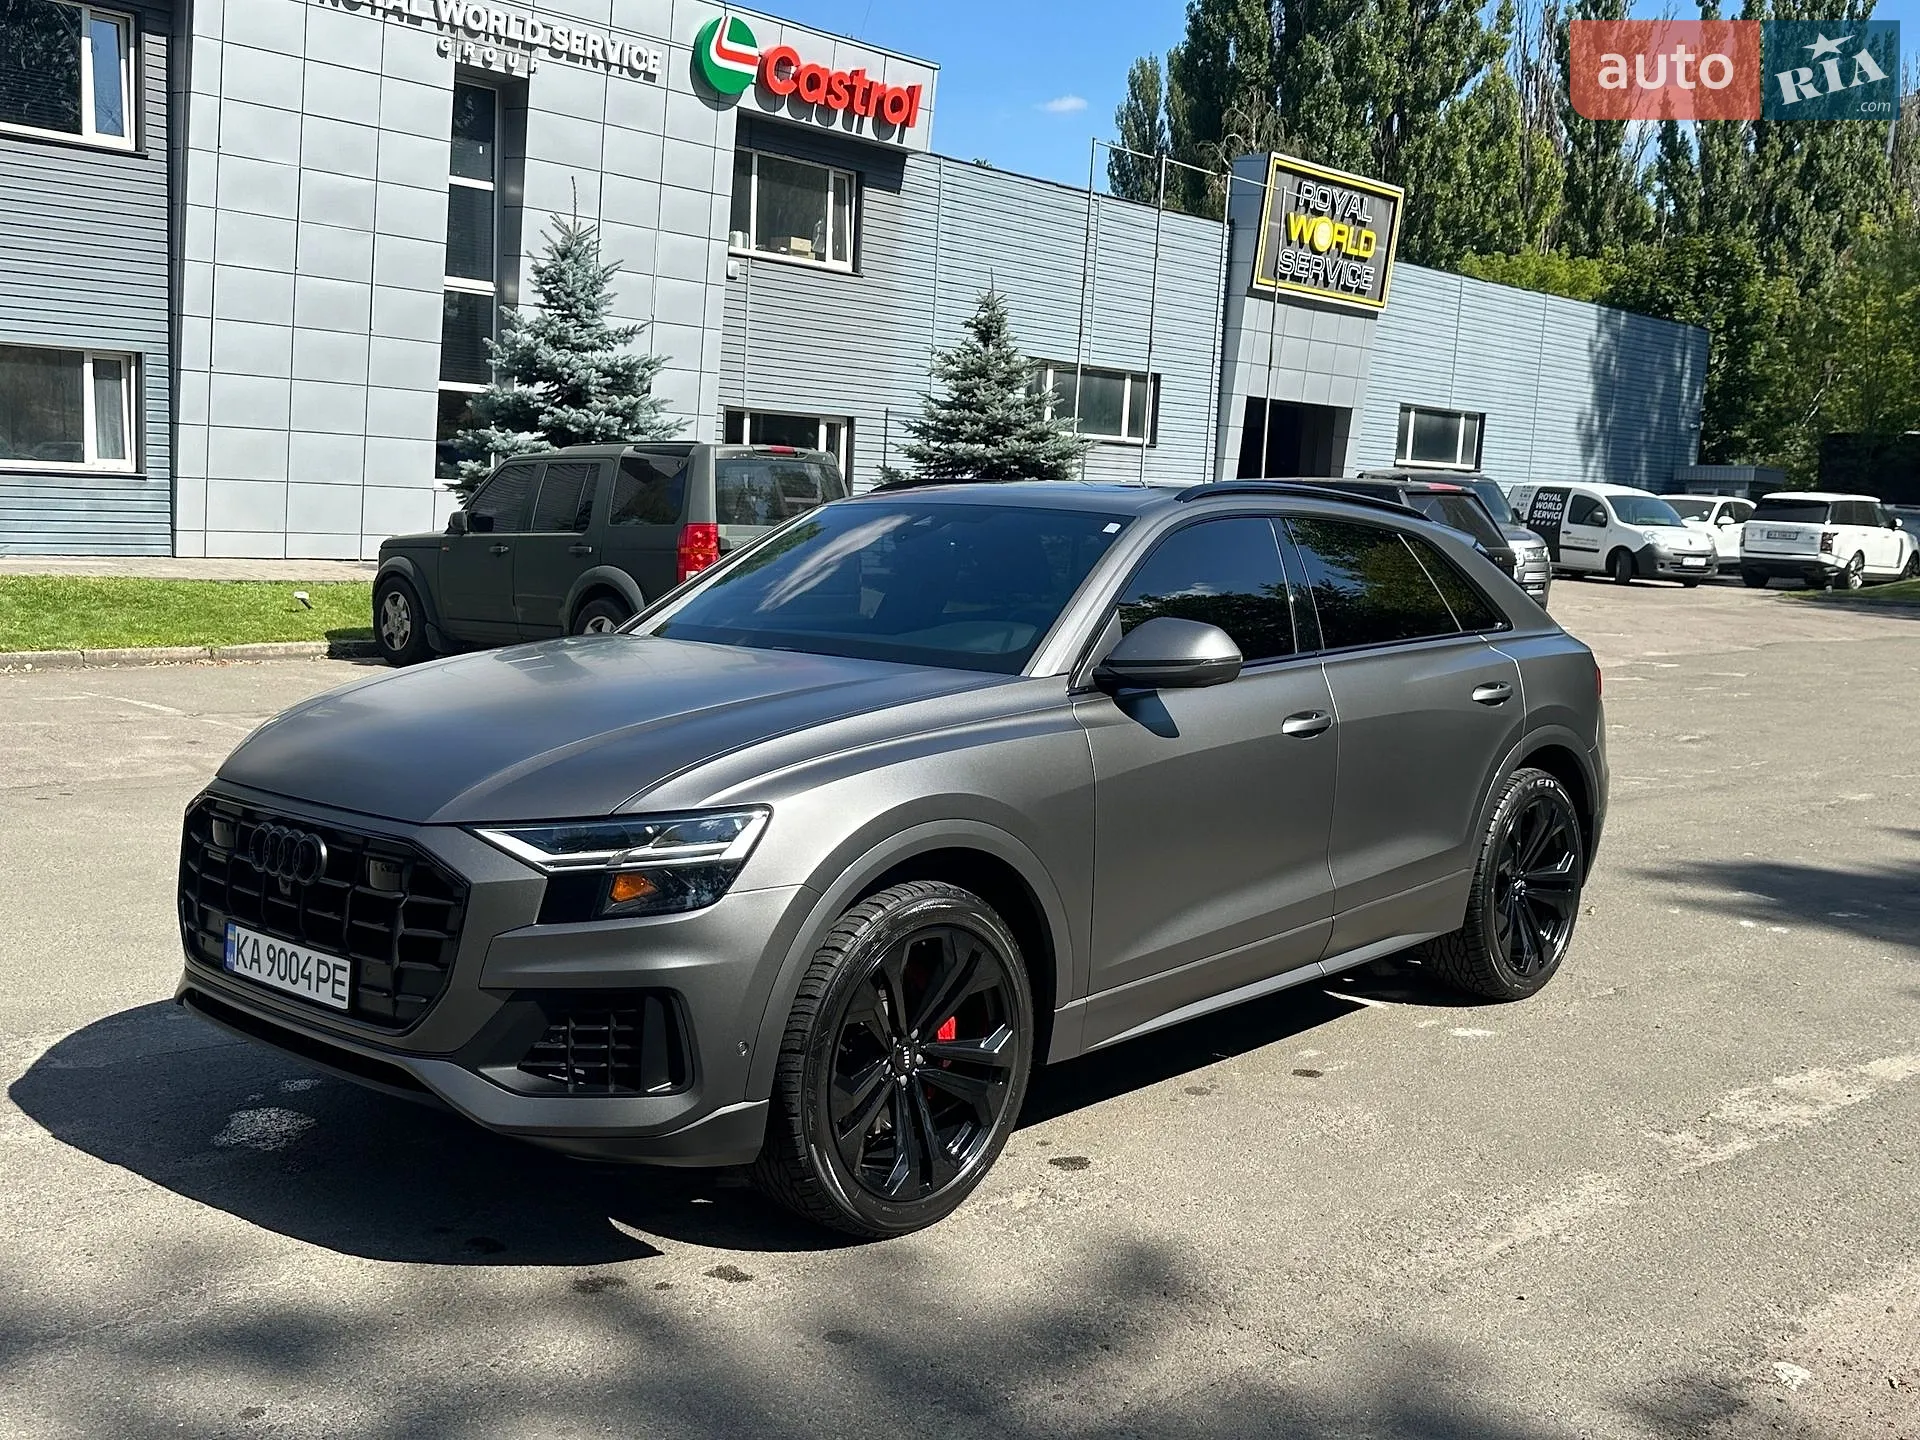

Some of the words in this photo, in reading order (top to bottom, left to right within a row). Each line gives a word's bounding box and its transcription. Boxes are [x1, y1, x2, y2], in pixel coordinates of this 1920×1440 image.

[434, 0, 544, 44] WORLD
[551, 25, 663, 75] SERVICE
[438, 37, 541, 74] GROUP
[761, 45, 922, 128] Castrol
[1299, 181, 1373, 223] ROYAL
[1288, 211, 1377, 259] WORLD
[1278, 249, 1376, 290] SERVICE
[1535, 501, 1563, 511] WORLD
[1537, 492, 1562, 502] ROYAL
[235, 932, 262, 975] KA
[266, 943, 313, 991] 9004
[315, 957, 348, 1002] PE
